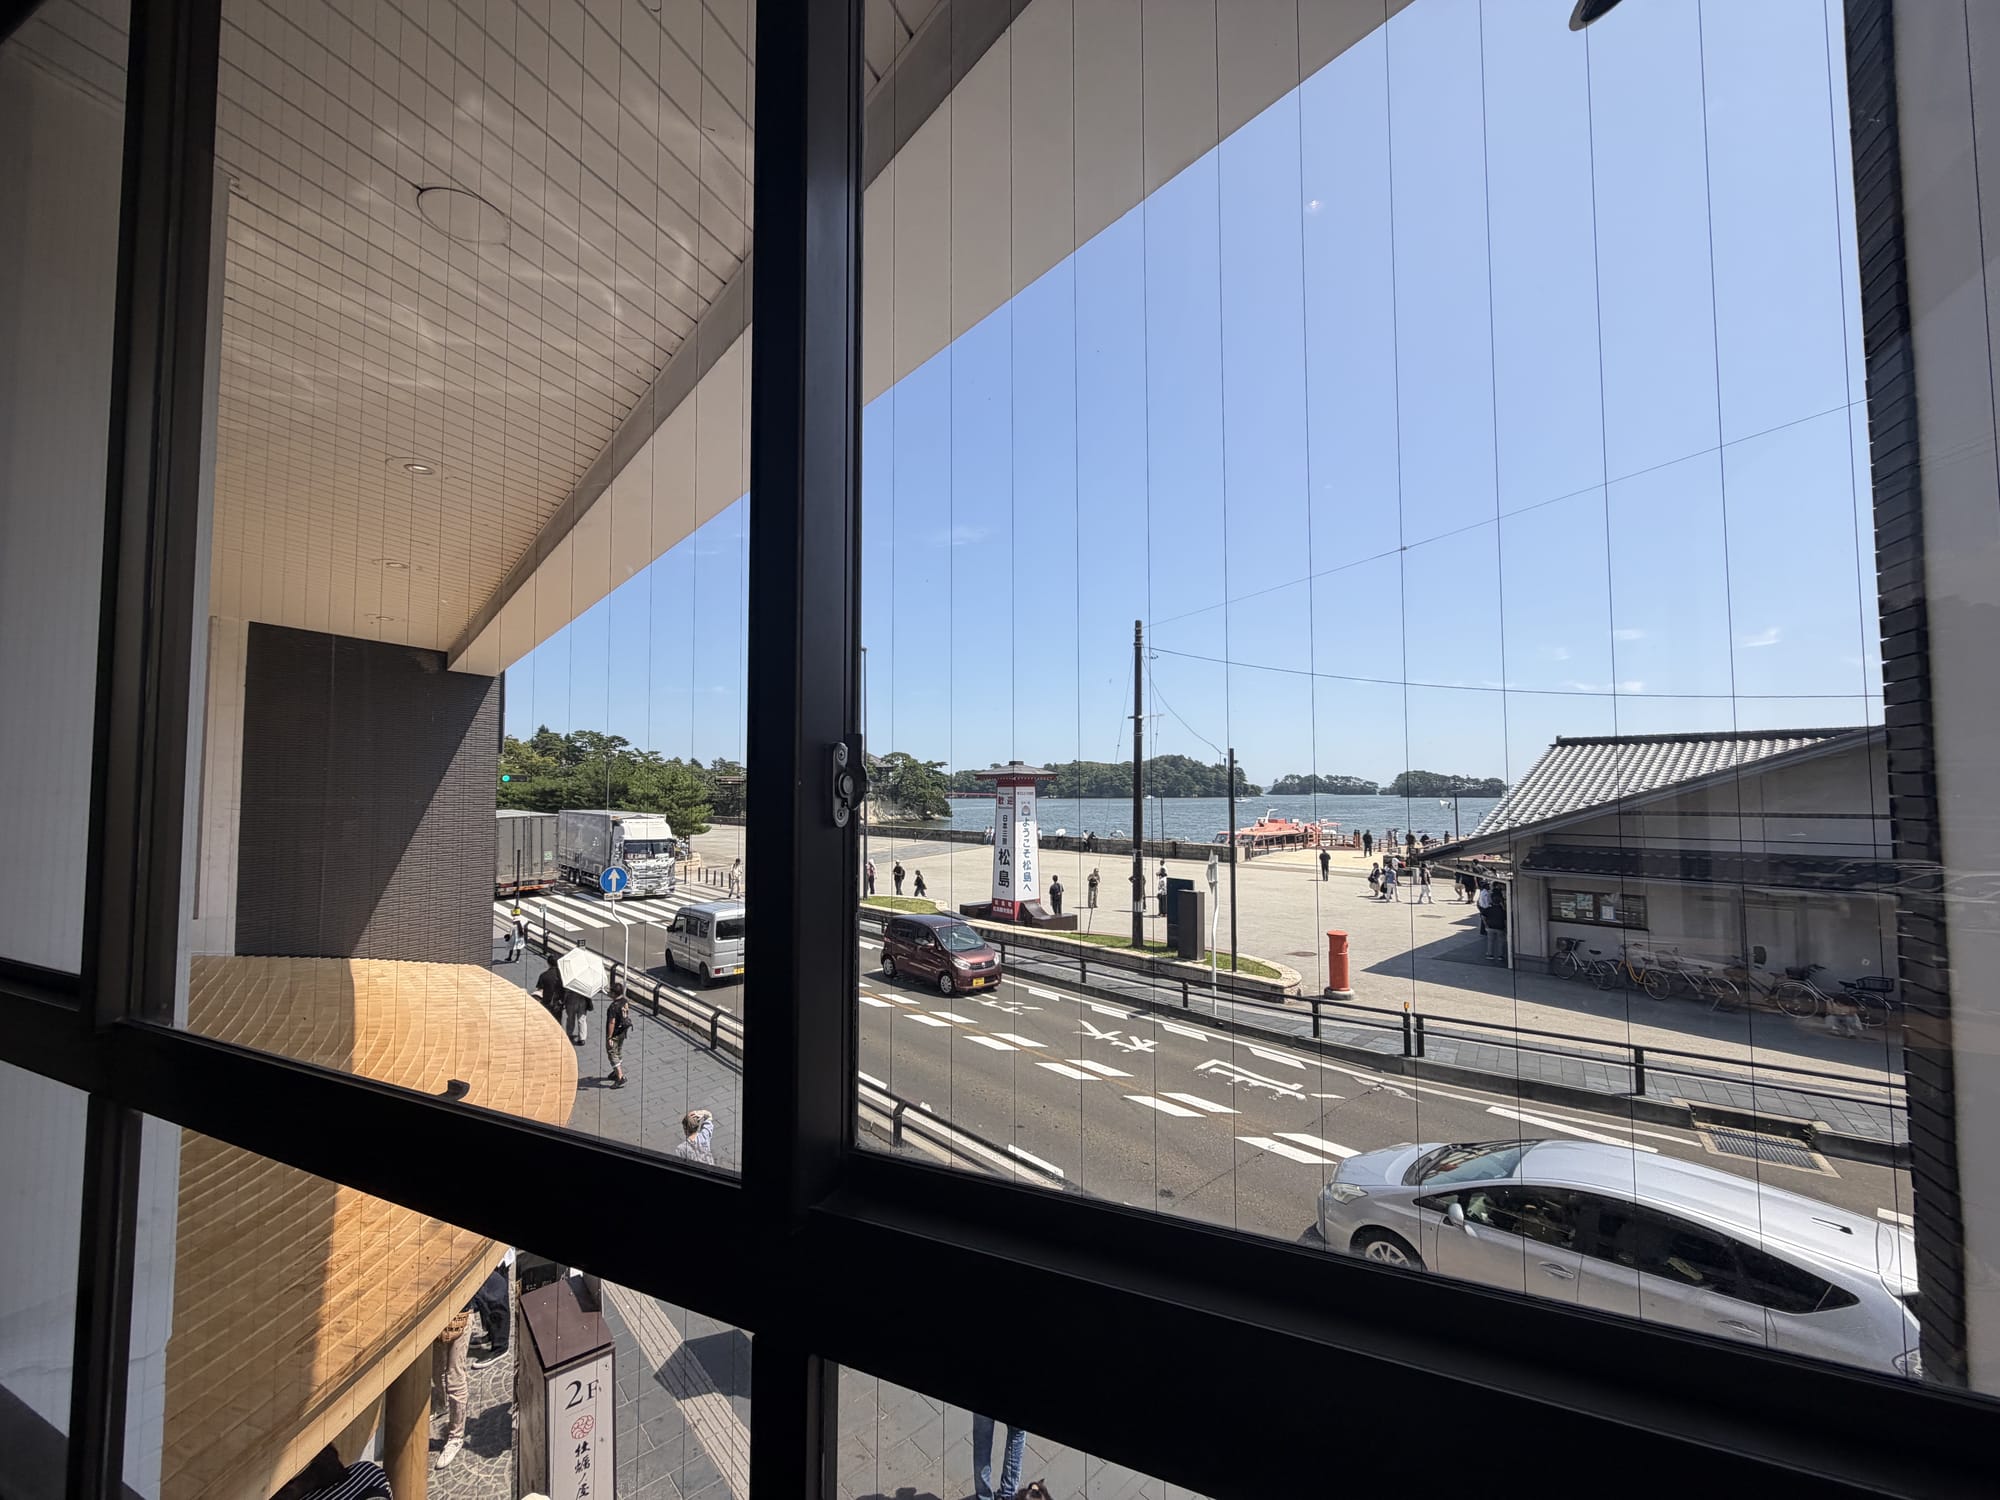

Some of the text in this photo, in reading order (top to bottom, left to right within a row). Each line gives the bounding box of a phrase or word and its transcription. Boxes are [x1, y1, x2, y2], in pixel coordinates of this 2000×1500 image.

[998, 848, 1010, 888] 松島
[1022, 817, 1032, 892] ようこそ松島へ
[565, 1379, 599, 1410] 2F
